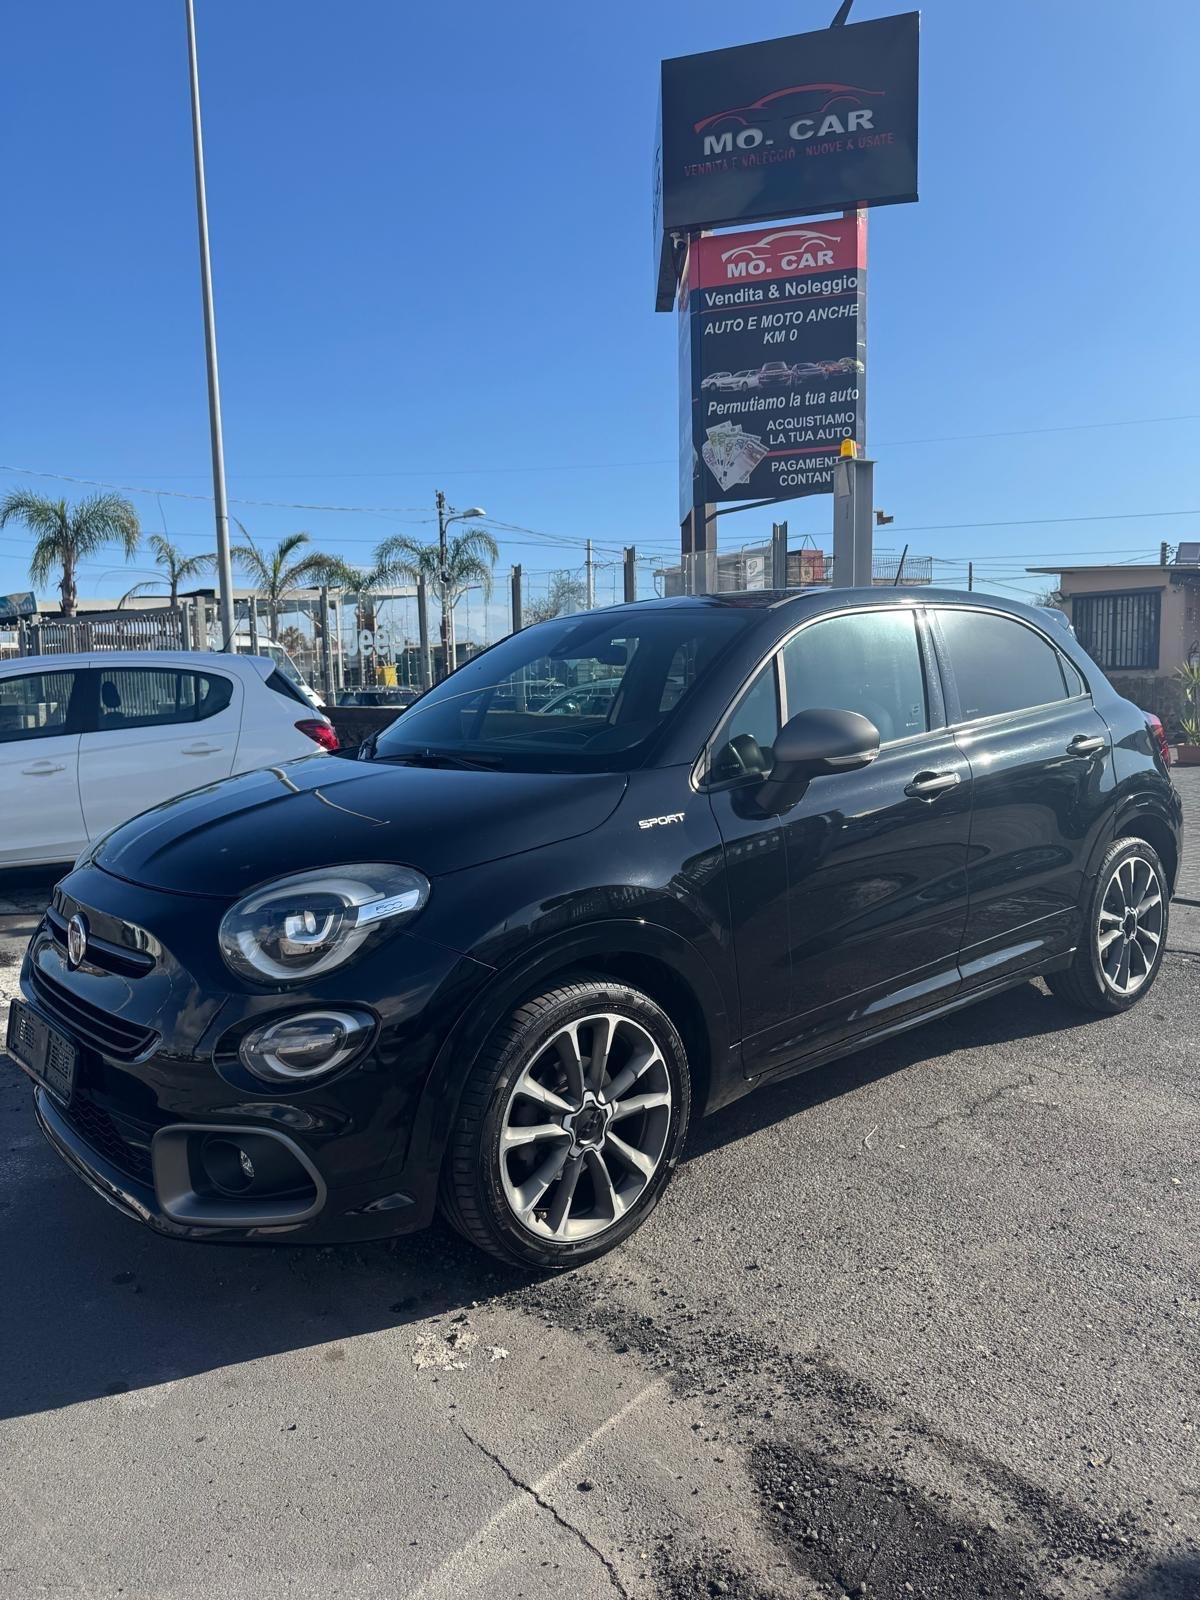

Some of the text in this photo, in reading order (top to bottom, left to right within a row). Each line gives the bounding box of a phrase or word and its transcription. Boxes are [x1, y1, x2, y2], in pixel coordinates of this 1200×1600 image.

[703, 109, 875, 156] MO. CAR
[805, 140, 843, 156] NUOVE
[858, 132, 895, 149] USATE
[727, 250, 834, 278] MO. CAR
[705, 275, 858, 306] Vendita & Noleggio
[704, 303, 859, 335] AUTO E MOTO ANCHE
[763, 329, 785, 344] KM
[707, 387, 859, 416] Permutiamo la tua auto
[766, 411, 855, 431] ACQUISTIAMO
[769, 426, 852, 445] LA TUA AUTO
[771, 456, 841, 473] PAGAMENT
[638, 812, 685, 829] SPORT
